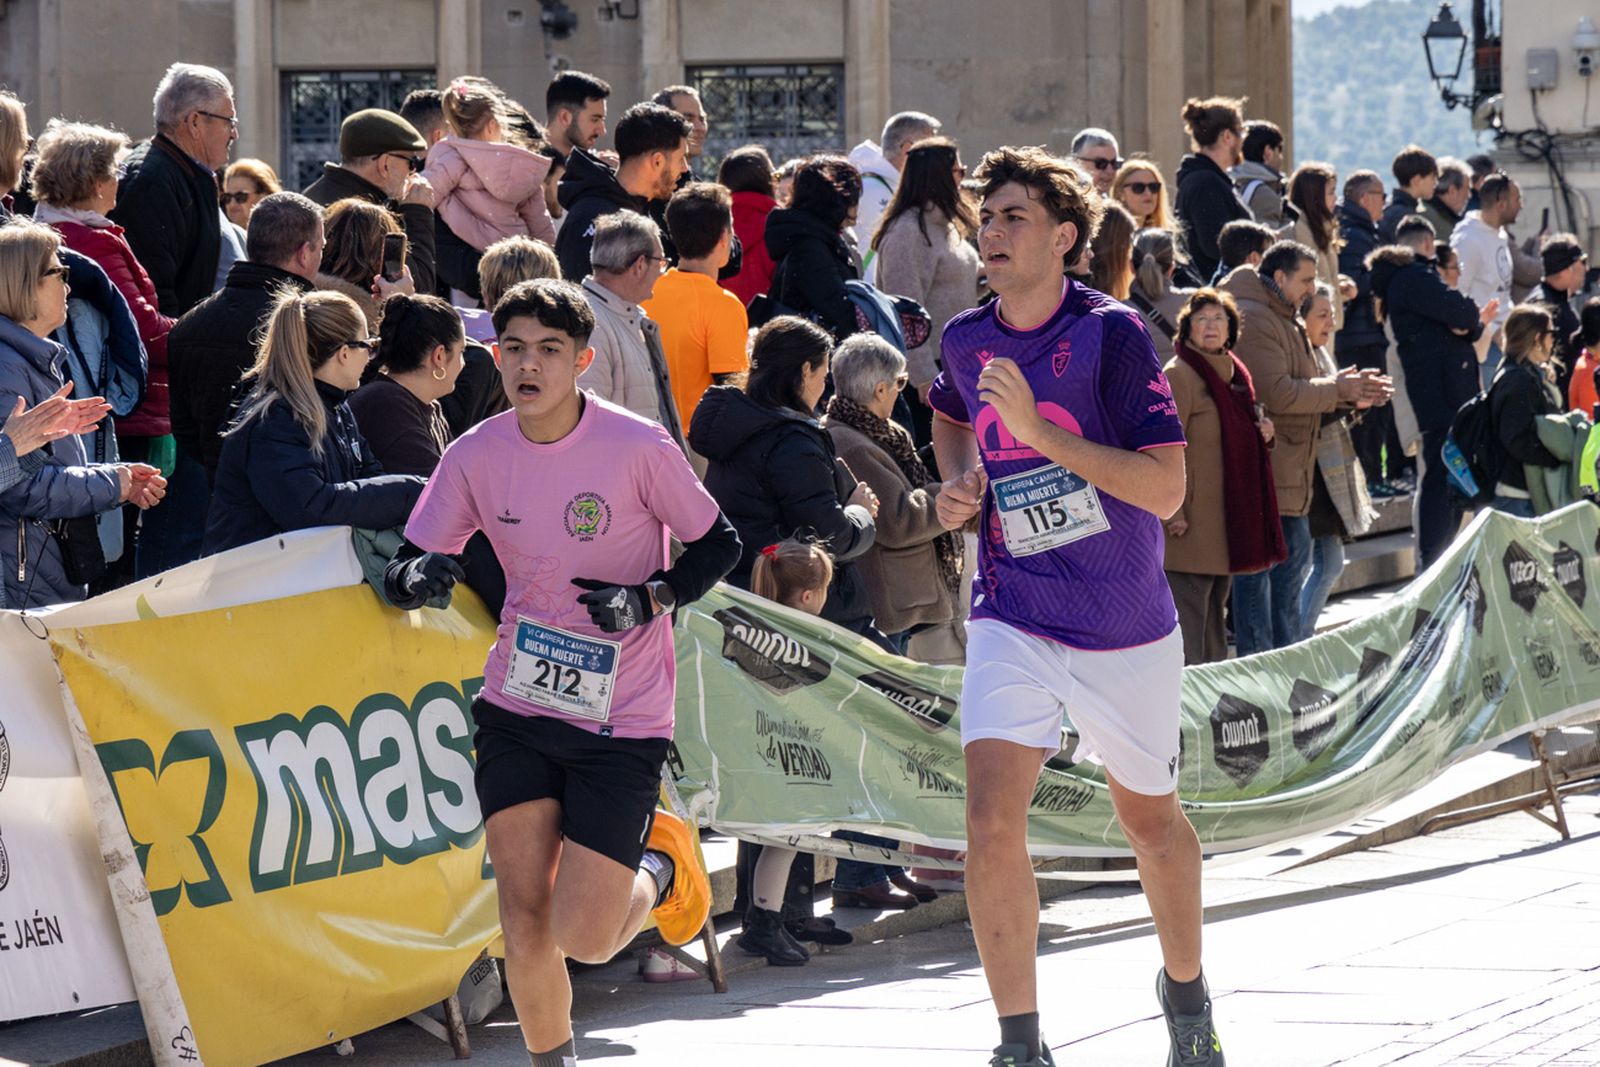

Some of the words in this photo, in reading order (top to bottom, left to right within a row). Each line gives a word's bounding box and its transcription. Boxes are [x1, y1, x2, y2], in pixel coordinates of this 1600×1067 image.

[1003, 493, 1028, 508] BUENA
[1026, 483, 1060, 502] MUERTE
[1023, 500, 1067, 533] 115
[524, 638, 549, 657] BUENA
[550, 646, 585, 666] MUERTE
[535, 630, 565, 646] CARRERA
[565, 640, 604, 656] CAMINATA
[532, 659, 582, 697] 212
[1222, 713, 1261, 749] ownat
[1299, 694, 1332, 732] ownat
[766, 735, 777, 760] de
[777, 740, 831, 781] VERDAD
[234, 676, 498, 894] mas
[1031, 783, 1096, 814] VERDAD
[14, 909, 64, 949] JAÉN
